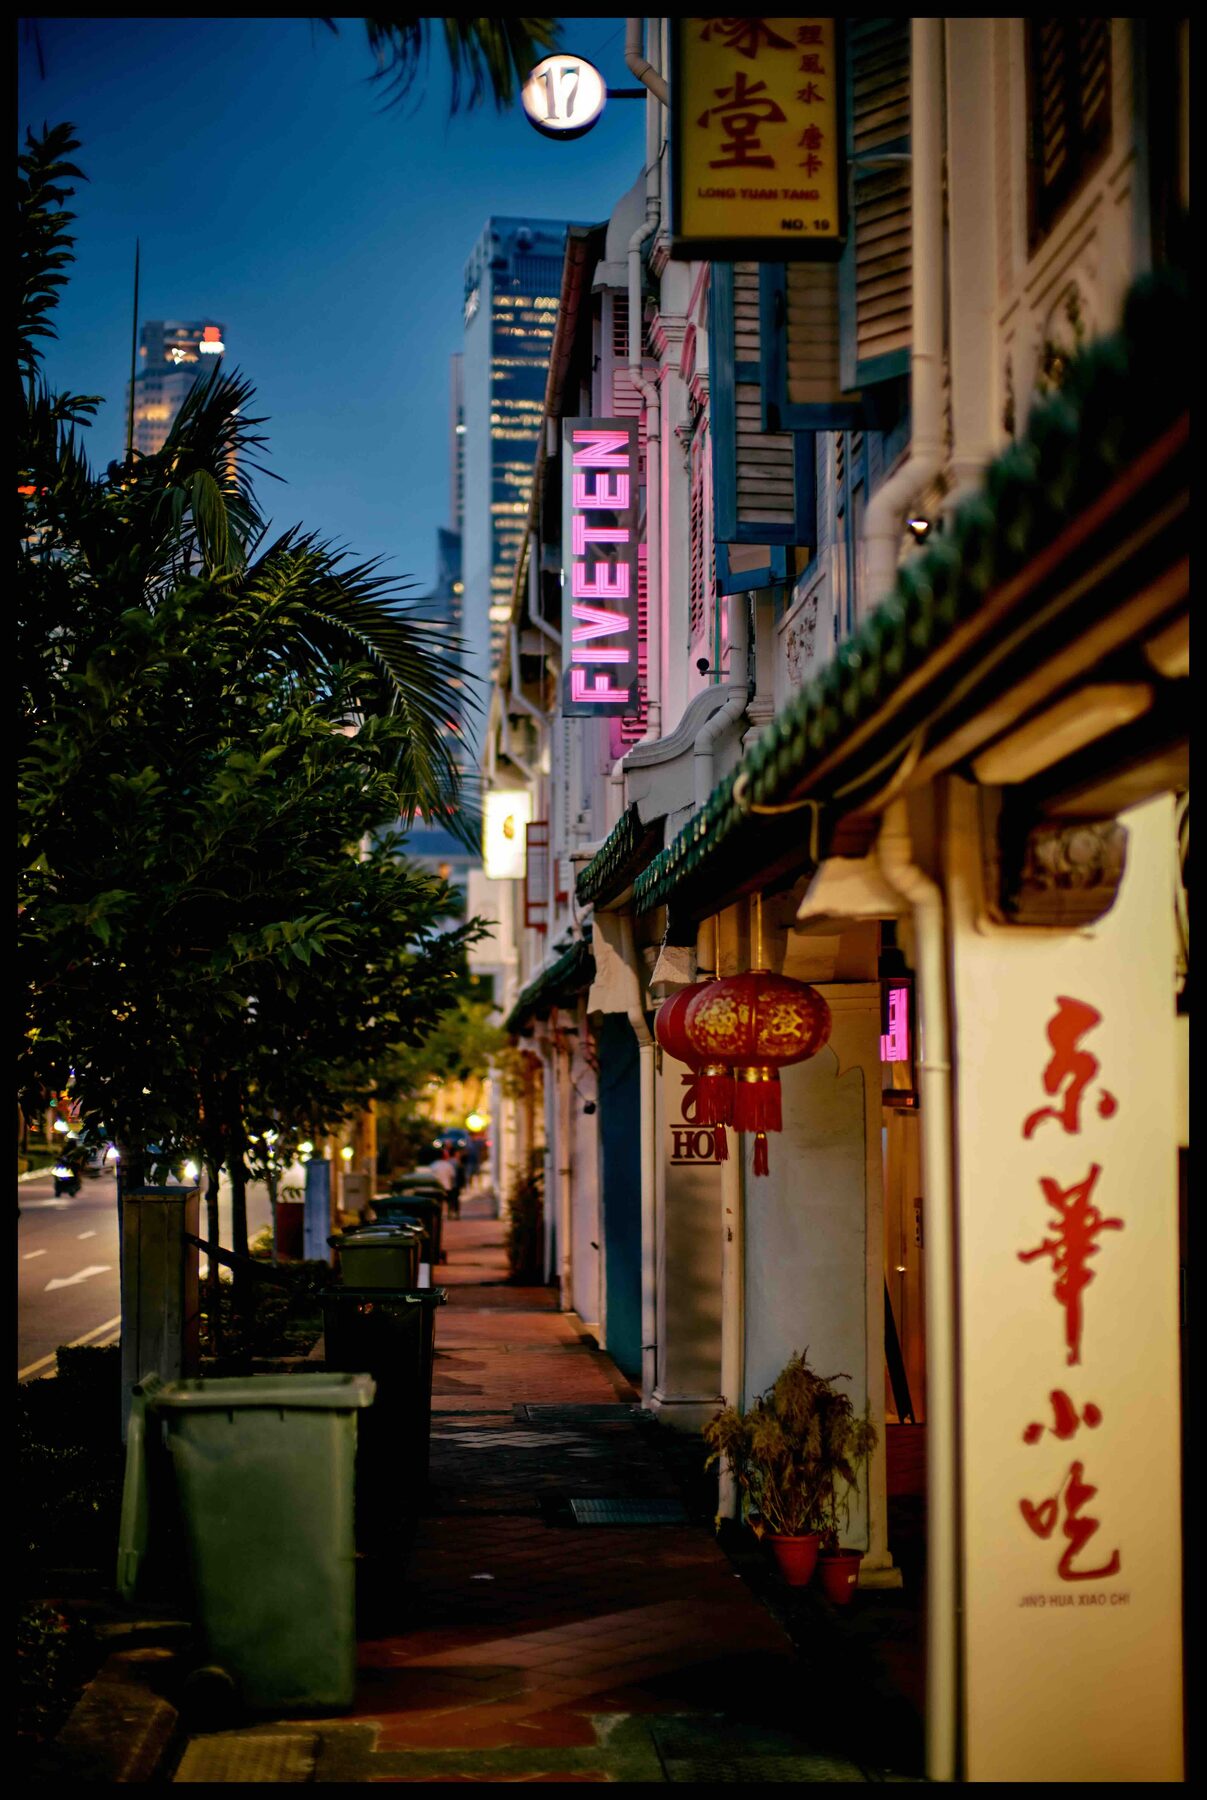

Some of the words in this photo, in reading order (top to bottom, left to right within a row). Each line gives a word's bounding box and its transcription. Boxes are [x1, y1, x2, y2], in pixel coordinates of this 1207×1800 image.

[536, 66, 580, 119] 17
[698, 187, 736, 199] LONG
[740, 188, 778, 200] YUAN
[781, 189, 820, 201] TANG
[781, 218, 808, 231] NO.
[571, 429, 630, 703] FIVETEN
[671, 1130, 715, 1159] HO
[1018, 1595, 1046, 1608] JING
[1049, 1594, 1074, 1607] HUA
[1078, 1593, 1106, 1607] XIAO
[1110, 1592, 1130, 1606] CHI
